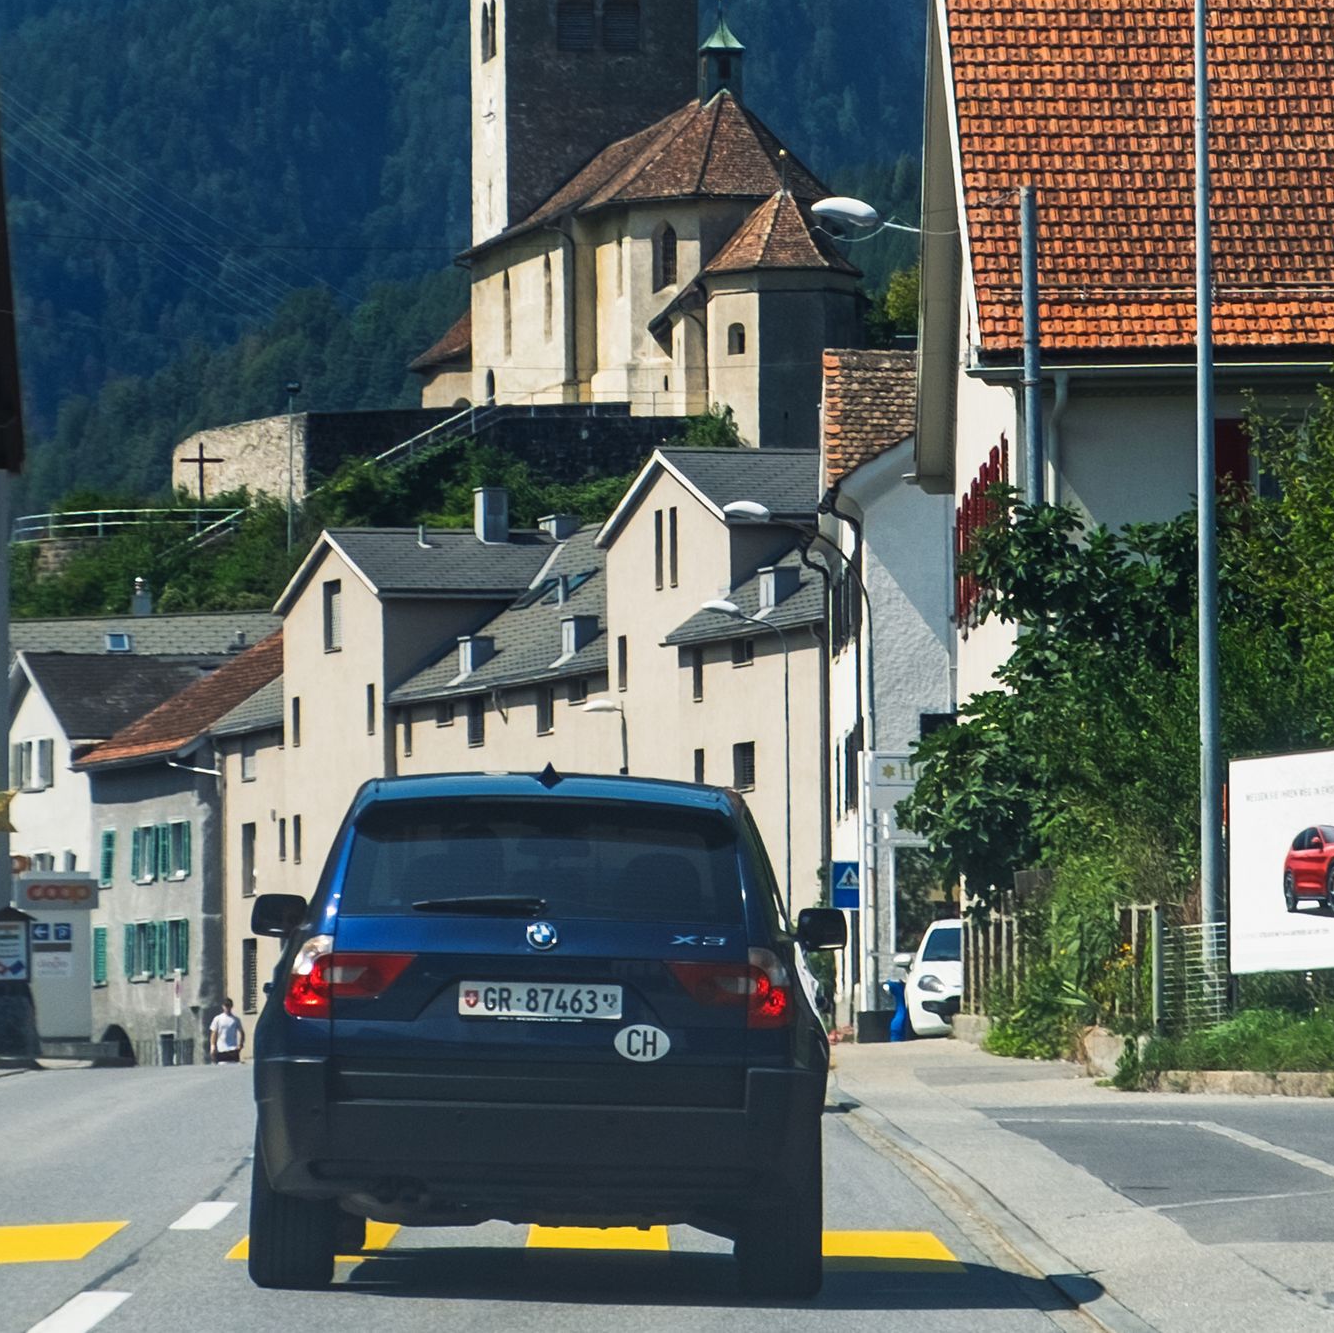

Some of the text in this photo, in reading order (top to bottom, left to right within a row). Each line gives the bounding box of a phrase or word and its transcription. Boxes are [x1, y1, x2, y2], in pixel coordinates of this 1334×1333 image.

[27, 884, 91, 904] coop
[668, 934, 727, 946] X3
[483, 986, 598, 1015] GR 87463
[626, 1028, 658, 1057] CH
